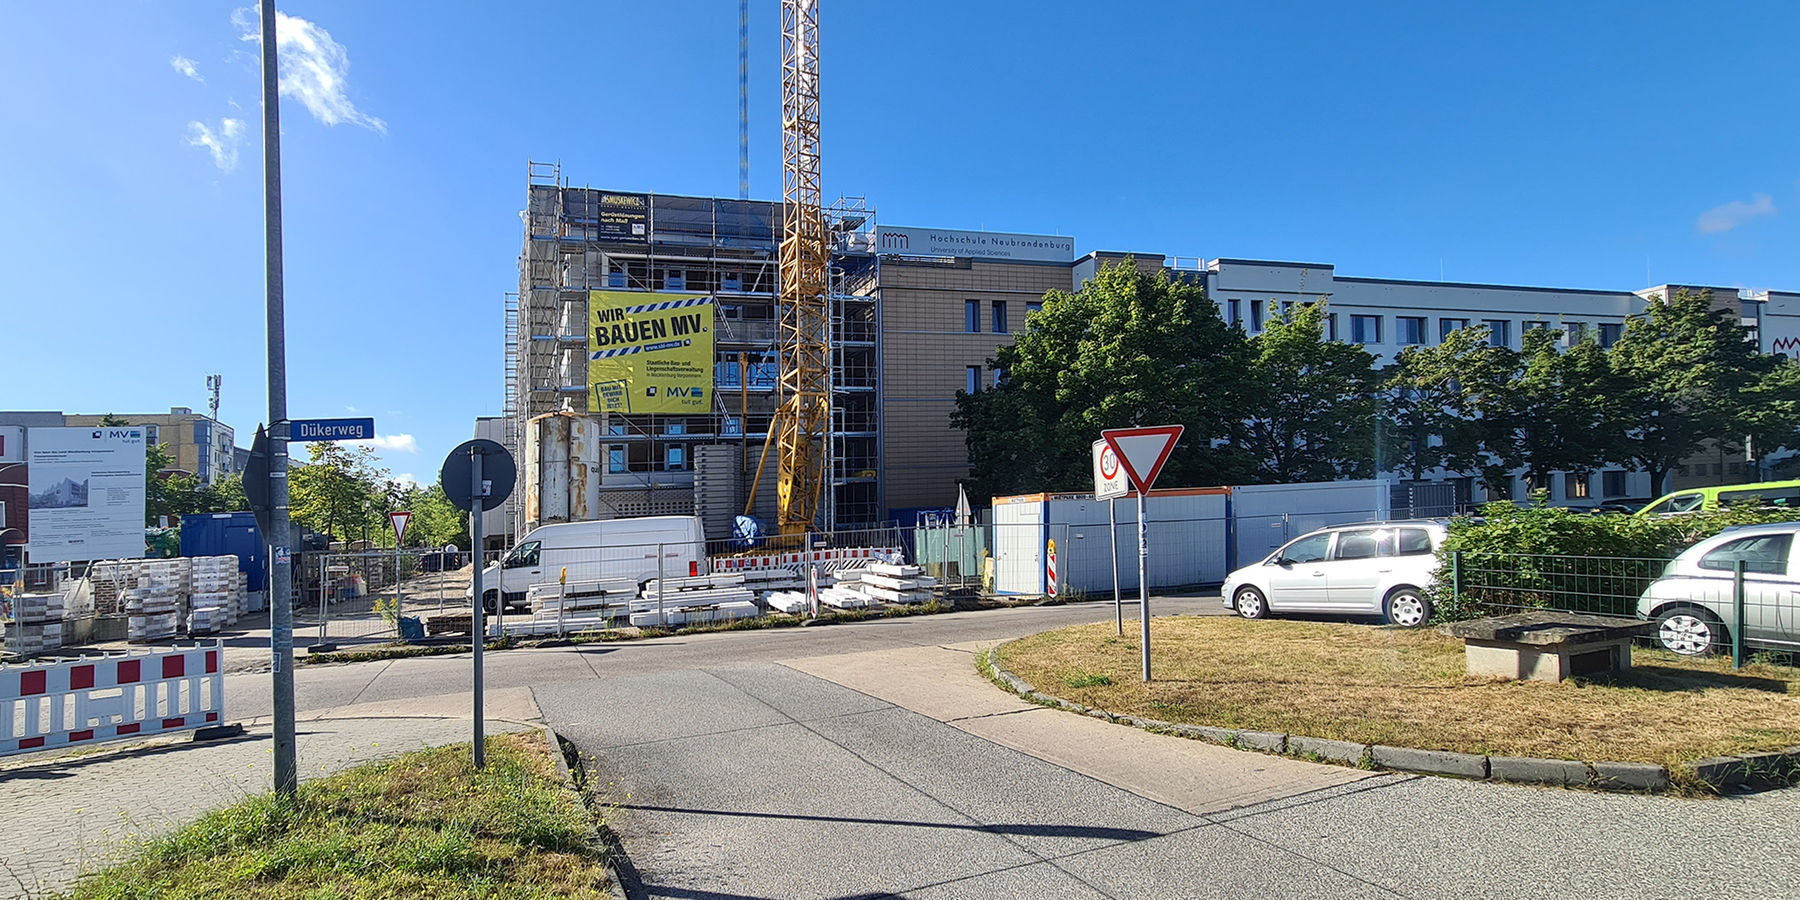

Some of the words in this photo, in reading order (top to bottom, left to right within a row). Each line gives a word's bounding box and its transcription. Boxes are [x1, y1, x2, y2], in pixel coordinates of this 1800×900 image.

[930, 234, 986, 245] Hochschule
[991, 238, 1071, 252] Neubrandenburg
[597, 308, 625, 323] WIR
[595, 318, 667, 347] BAUEN
[667, 387, 690, 398] MV
[109, 430, 130, 439] MV
[300, 423, 364, 438] Dükerweg
[1103, 452, 1116, 472] 30
[1103, 480, 1119, 493] ZONE
